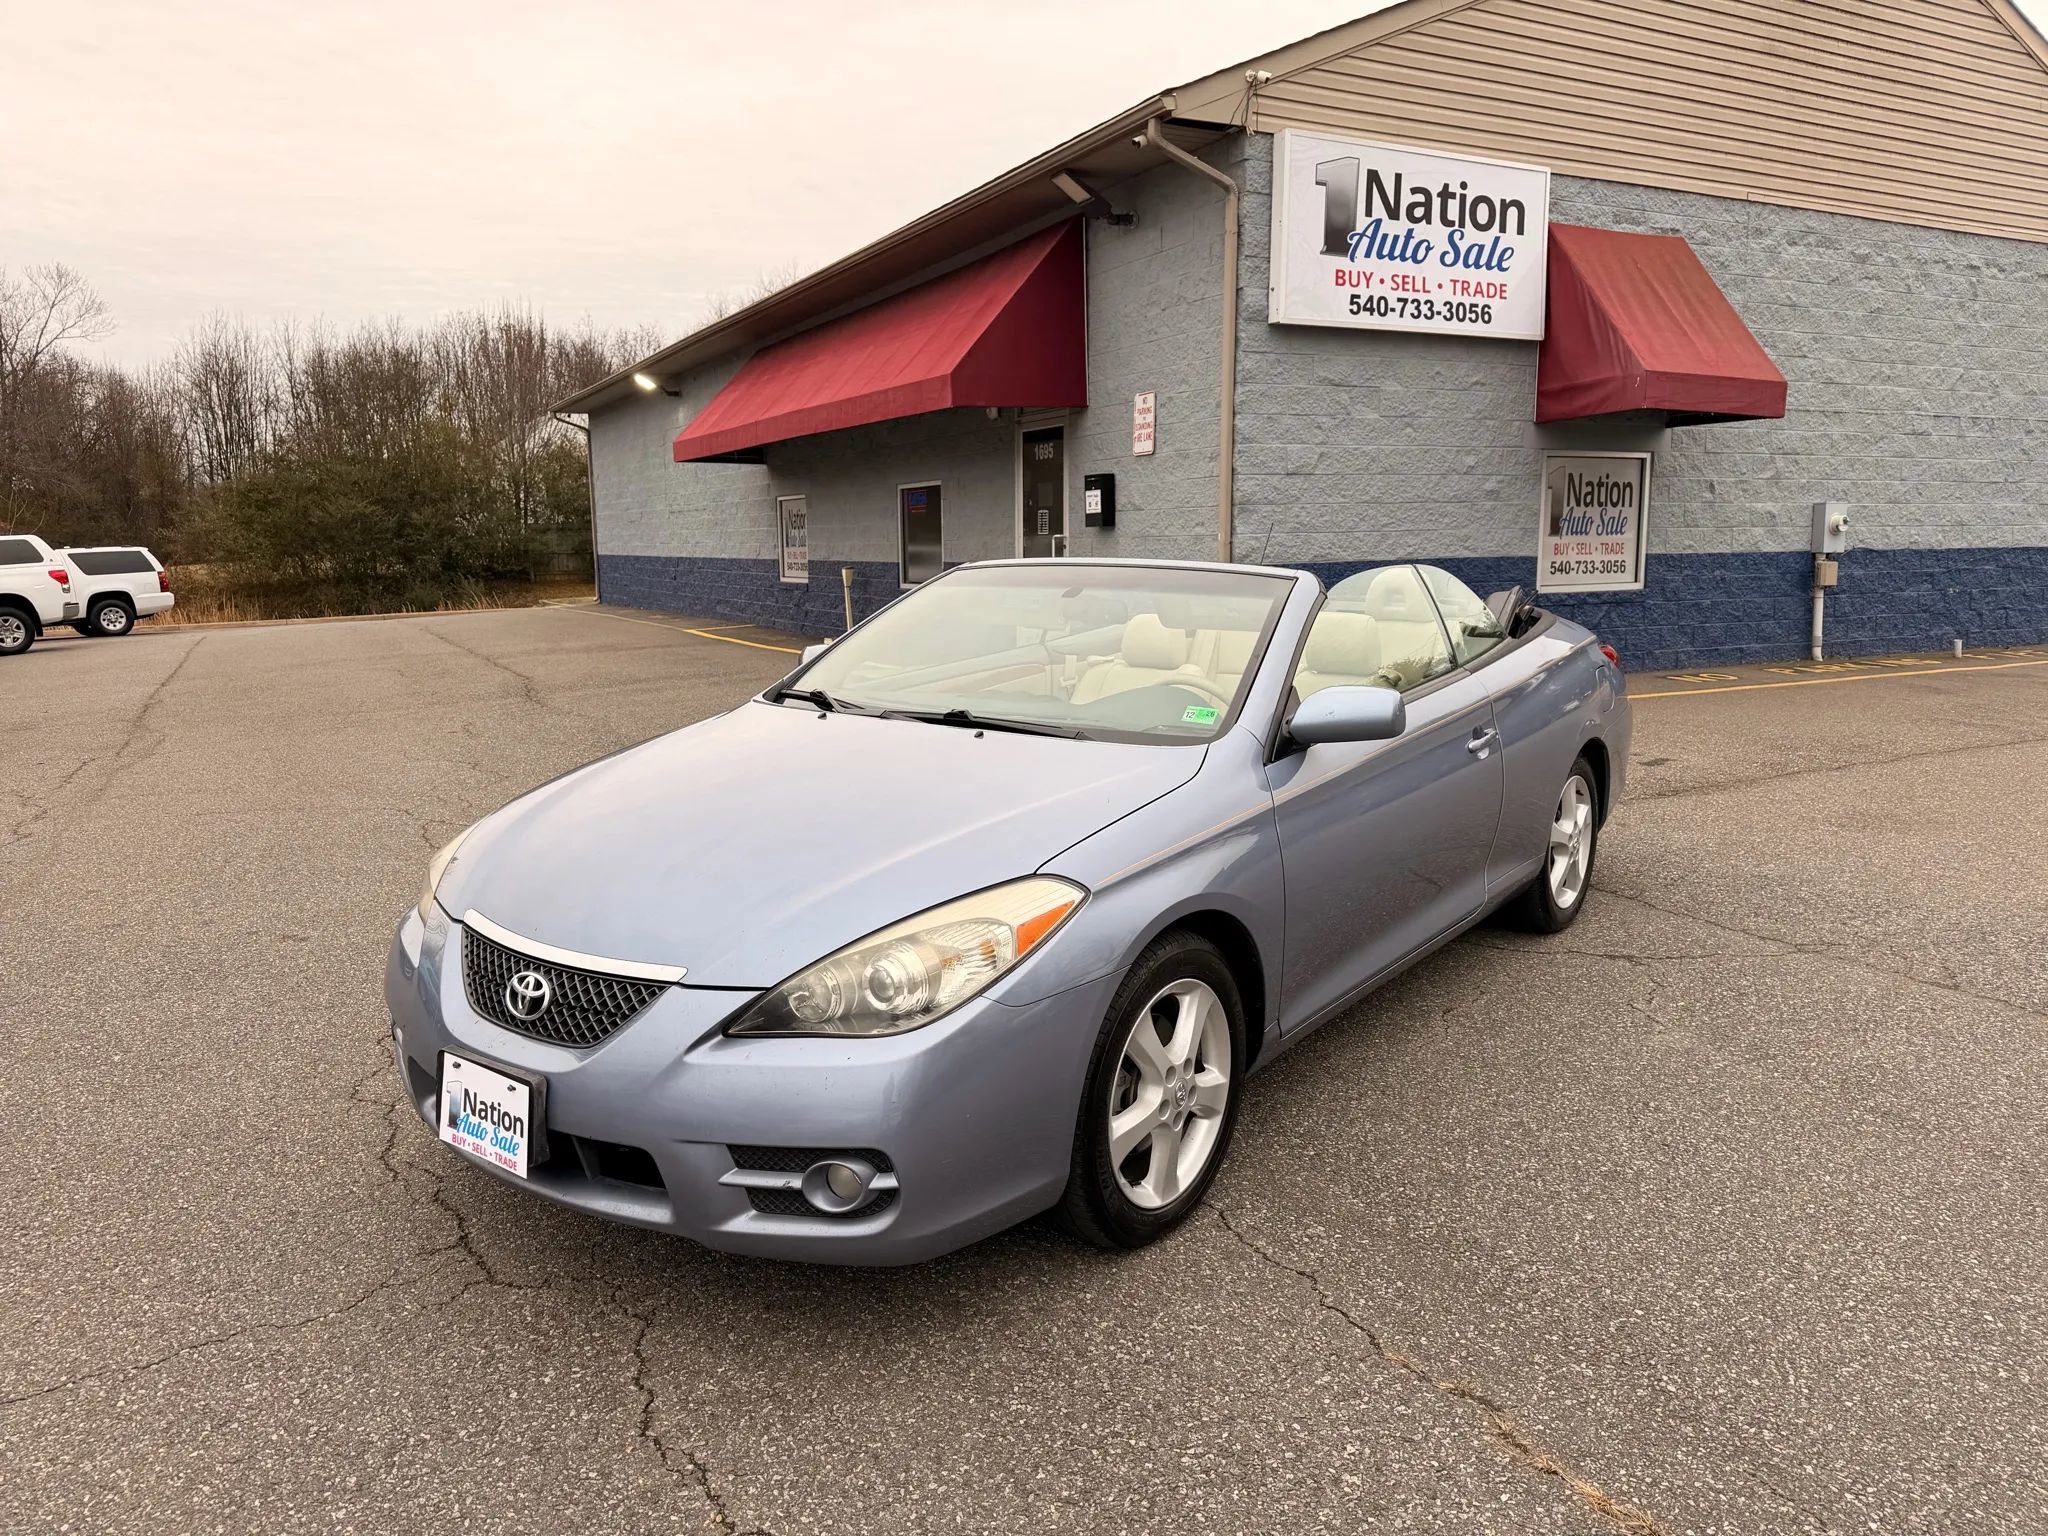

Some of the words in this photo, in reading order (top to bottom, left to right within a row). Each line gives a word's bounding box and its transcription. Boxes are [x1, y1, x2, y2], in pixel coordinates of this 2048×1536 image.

[1315, 156, 1360, 258] 1
[1364, 168, 1526, 236] Nation
[1346, 217, 1435, 264] Auto
[1439, 229, 1515, 273] Sale
[1335, 268, 1374, 288] BUY
[1390, 274, 1431, 294] SELL
[1450, 279, 1508, 300] TRADE
[1348, 294, 1493, 324] 540-733-3056
[1035, 443, 1054, 460] 1695
[1548, 466, 1566, 537] 1
[1567, 472, 1634, 508] Nation
[1560, 507, 1594, 539] Auto
[1596, 508, 1628, 537] Sale
[1554, 543, 1570, 555] BUY
[1576, 543, 1593, 555] SELL
[1600, 542, 1625, 555] TRADE
[1550, 560, 1626, 575] 540-733-3056
[1666, 673, 1740, 683] NO
[1185, 711, 1195, 719] 12
[463, 1087, 524, 1138] Nation
[456, 1112, 488, 1141] Auto
[490, 1126, 520, 1156] Sale
[451, 1133, 467, 1147] BUY
[472, 1142, 488, 1158] SELL
[495, 1151, 518, 1171] TRADE
